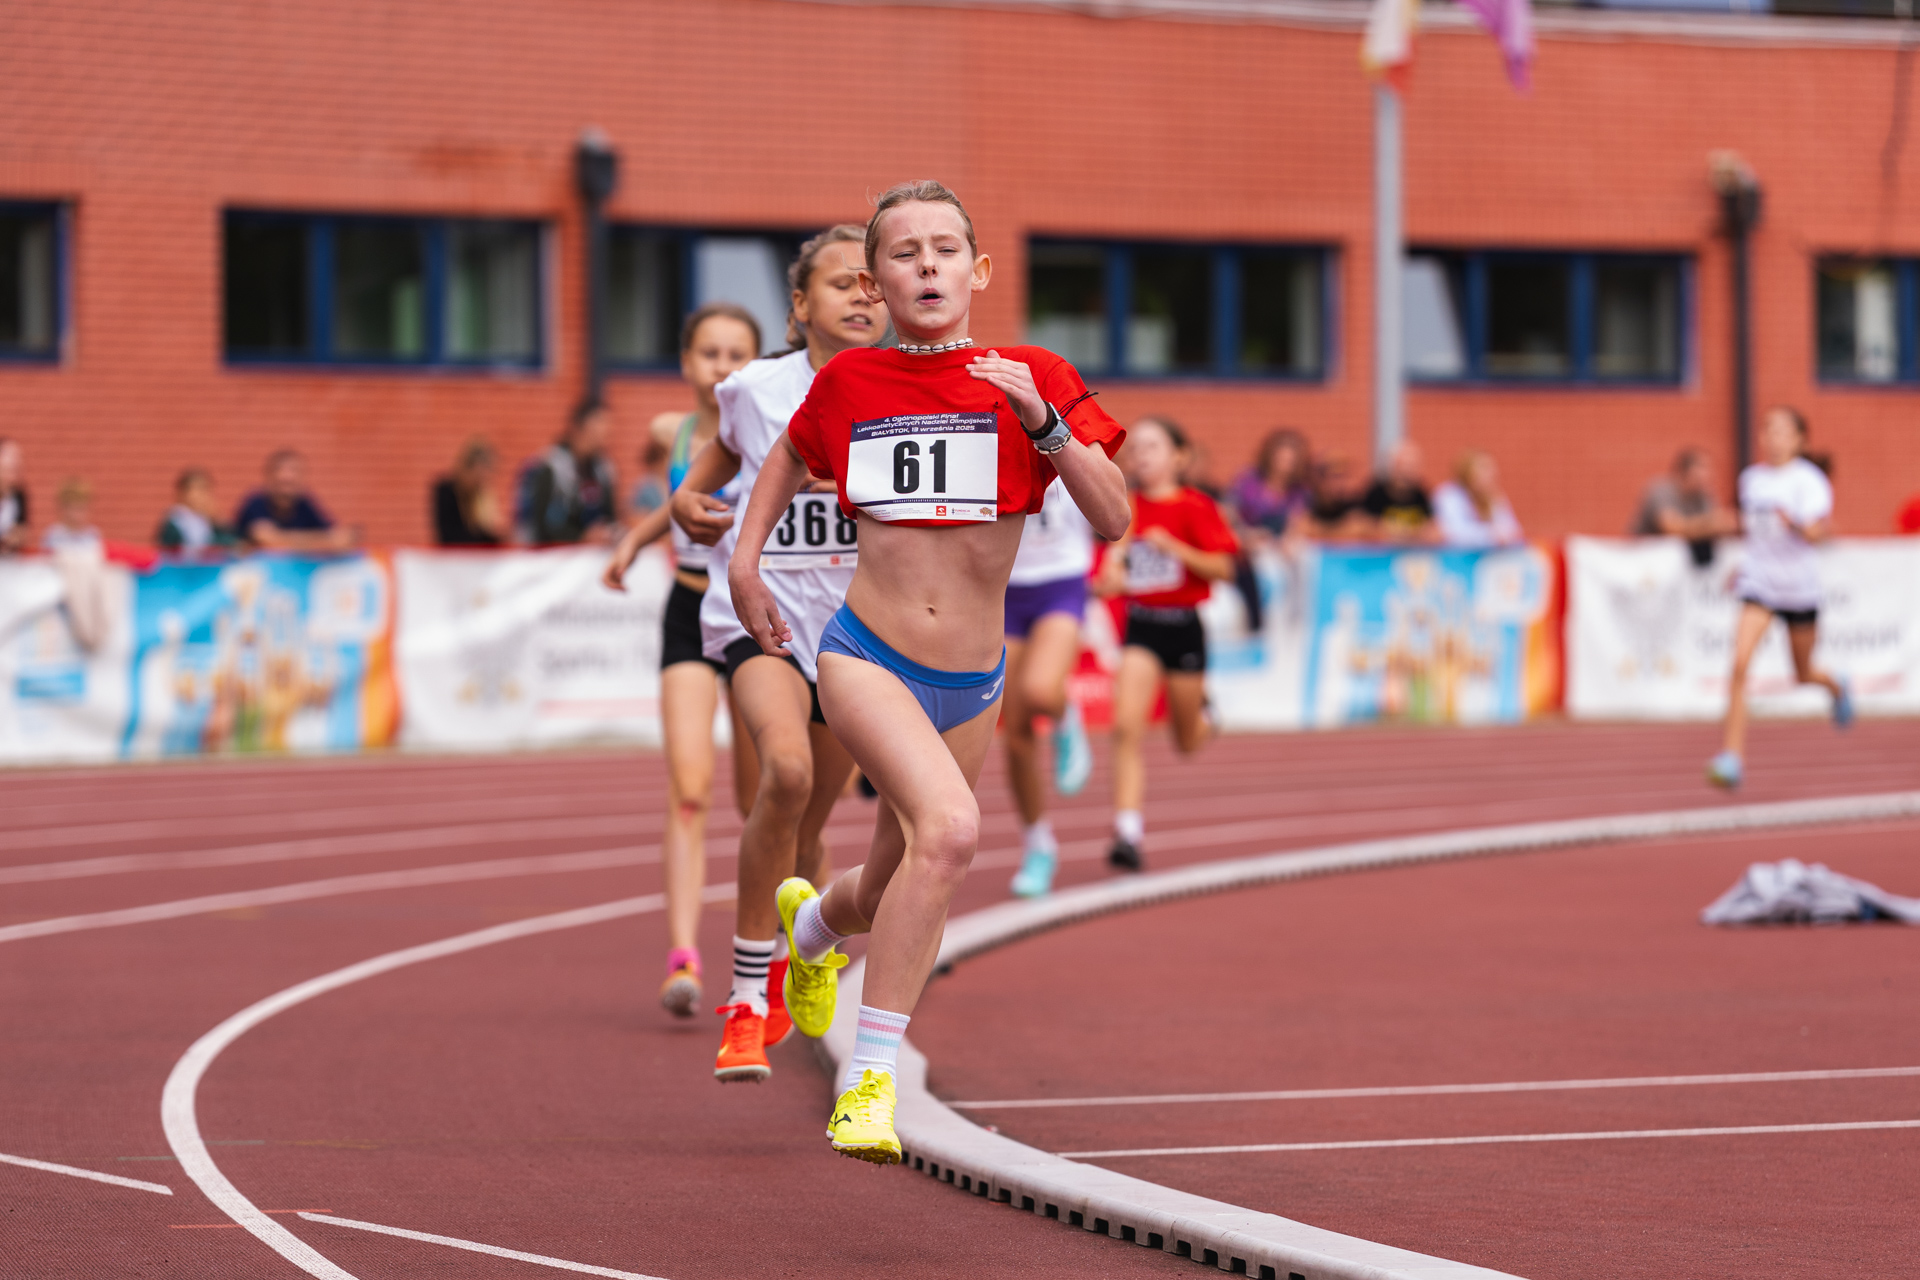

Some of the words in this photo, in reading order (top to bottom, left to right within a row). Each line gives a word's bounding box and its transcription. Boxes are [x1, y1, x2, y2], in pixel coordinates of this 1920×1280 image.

[892, 414, 939, 423] Ogólnopolski
[857, 420, 920, 433] Lekkoatletycznych
[871, 427, 910, 436] BIAŁYSTOK,
[893, 439, 947, 494] 61
[777, 500, 857, 546] 368
